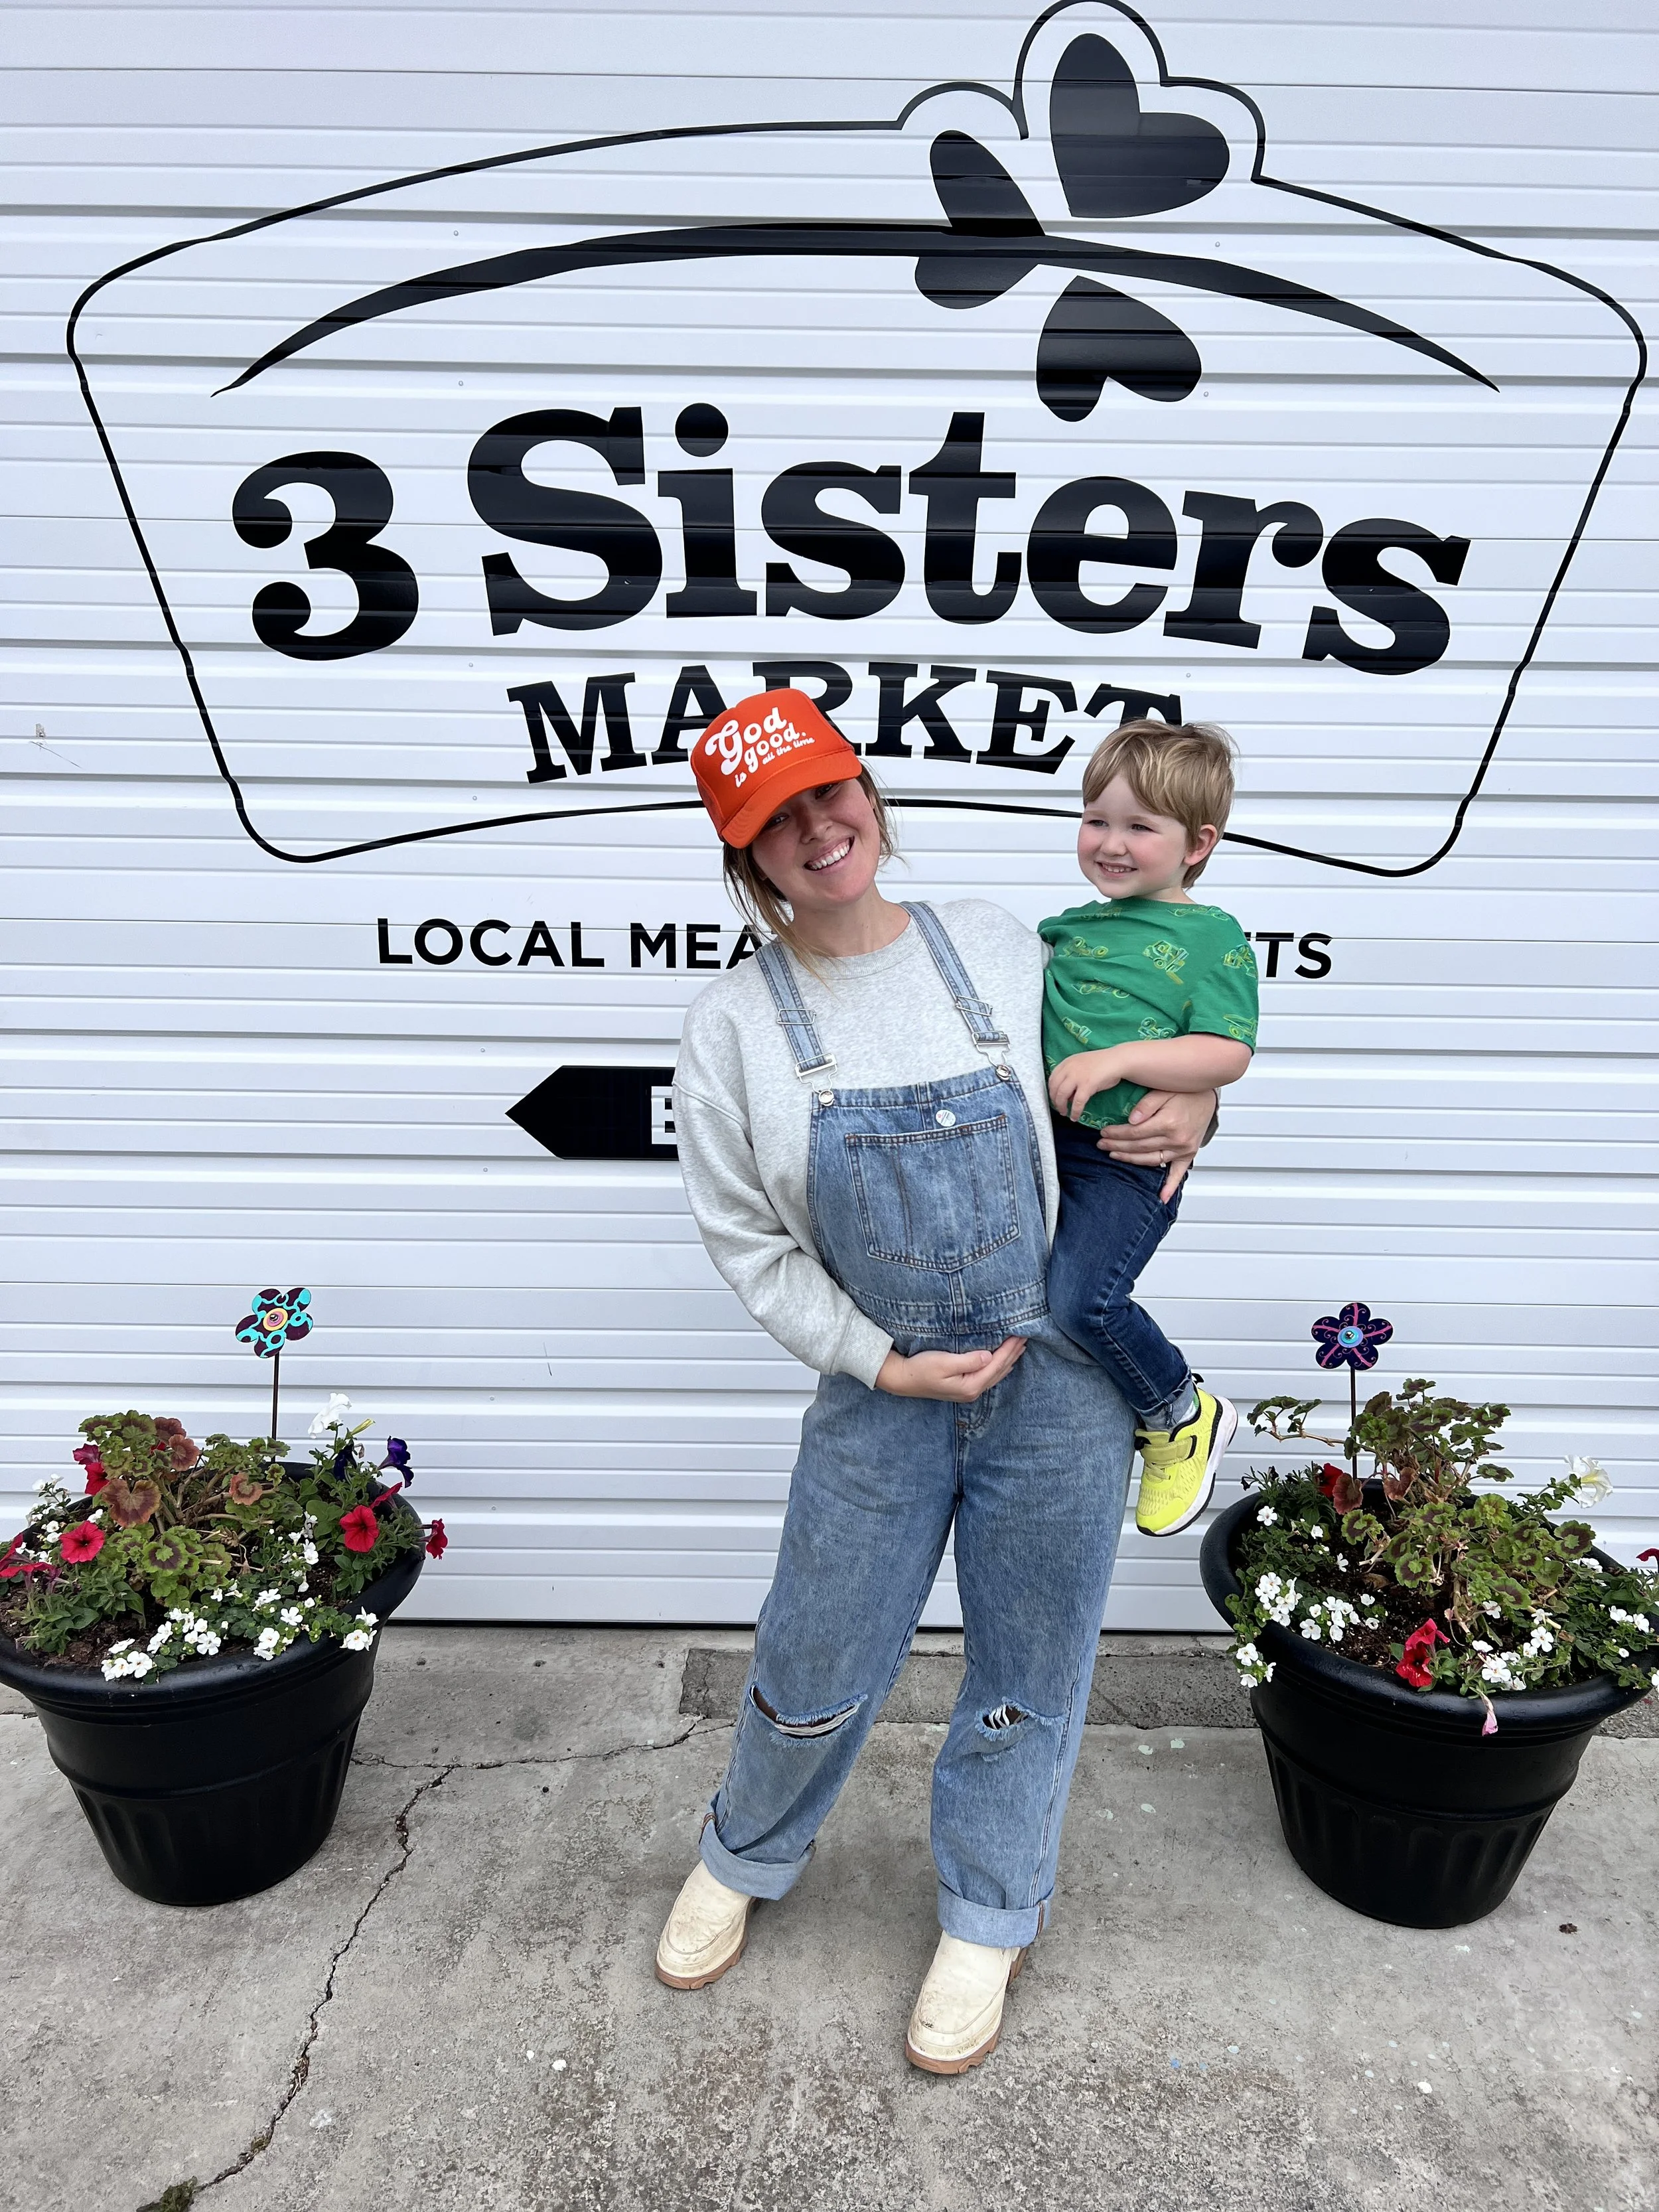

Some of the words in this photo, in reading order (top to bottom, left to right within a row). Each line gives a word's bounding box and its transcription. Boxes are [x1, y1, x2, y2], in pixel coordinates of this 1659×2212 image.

[232, 451, 419, 660] 3
[468, 404, 1471, 676] Sisters
[705, 707, 787, 775] God
[735, 772, 747, 788] is
[744, 722, 806, 773] good.
[762, 751, 775, 765] all
[776, 743, 792, 757] the
[793, 737, 815, 749] time
[377, 918, 605, 968] LOCAL
[630, 922, 778, 969] MEA
[1244, 932, 1333, 979] TS
